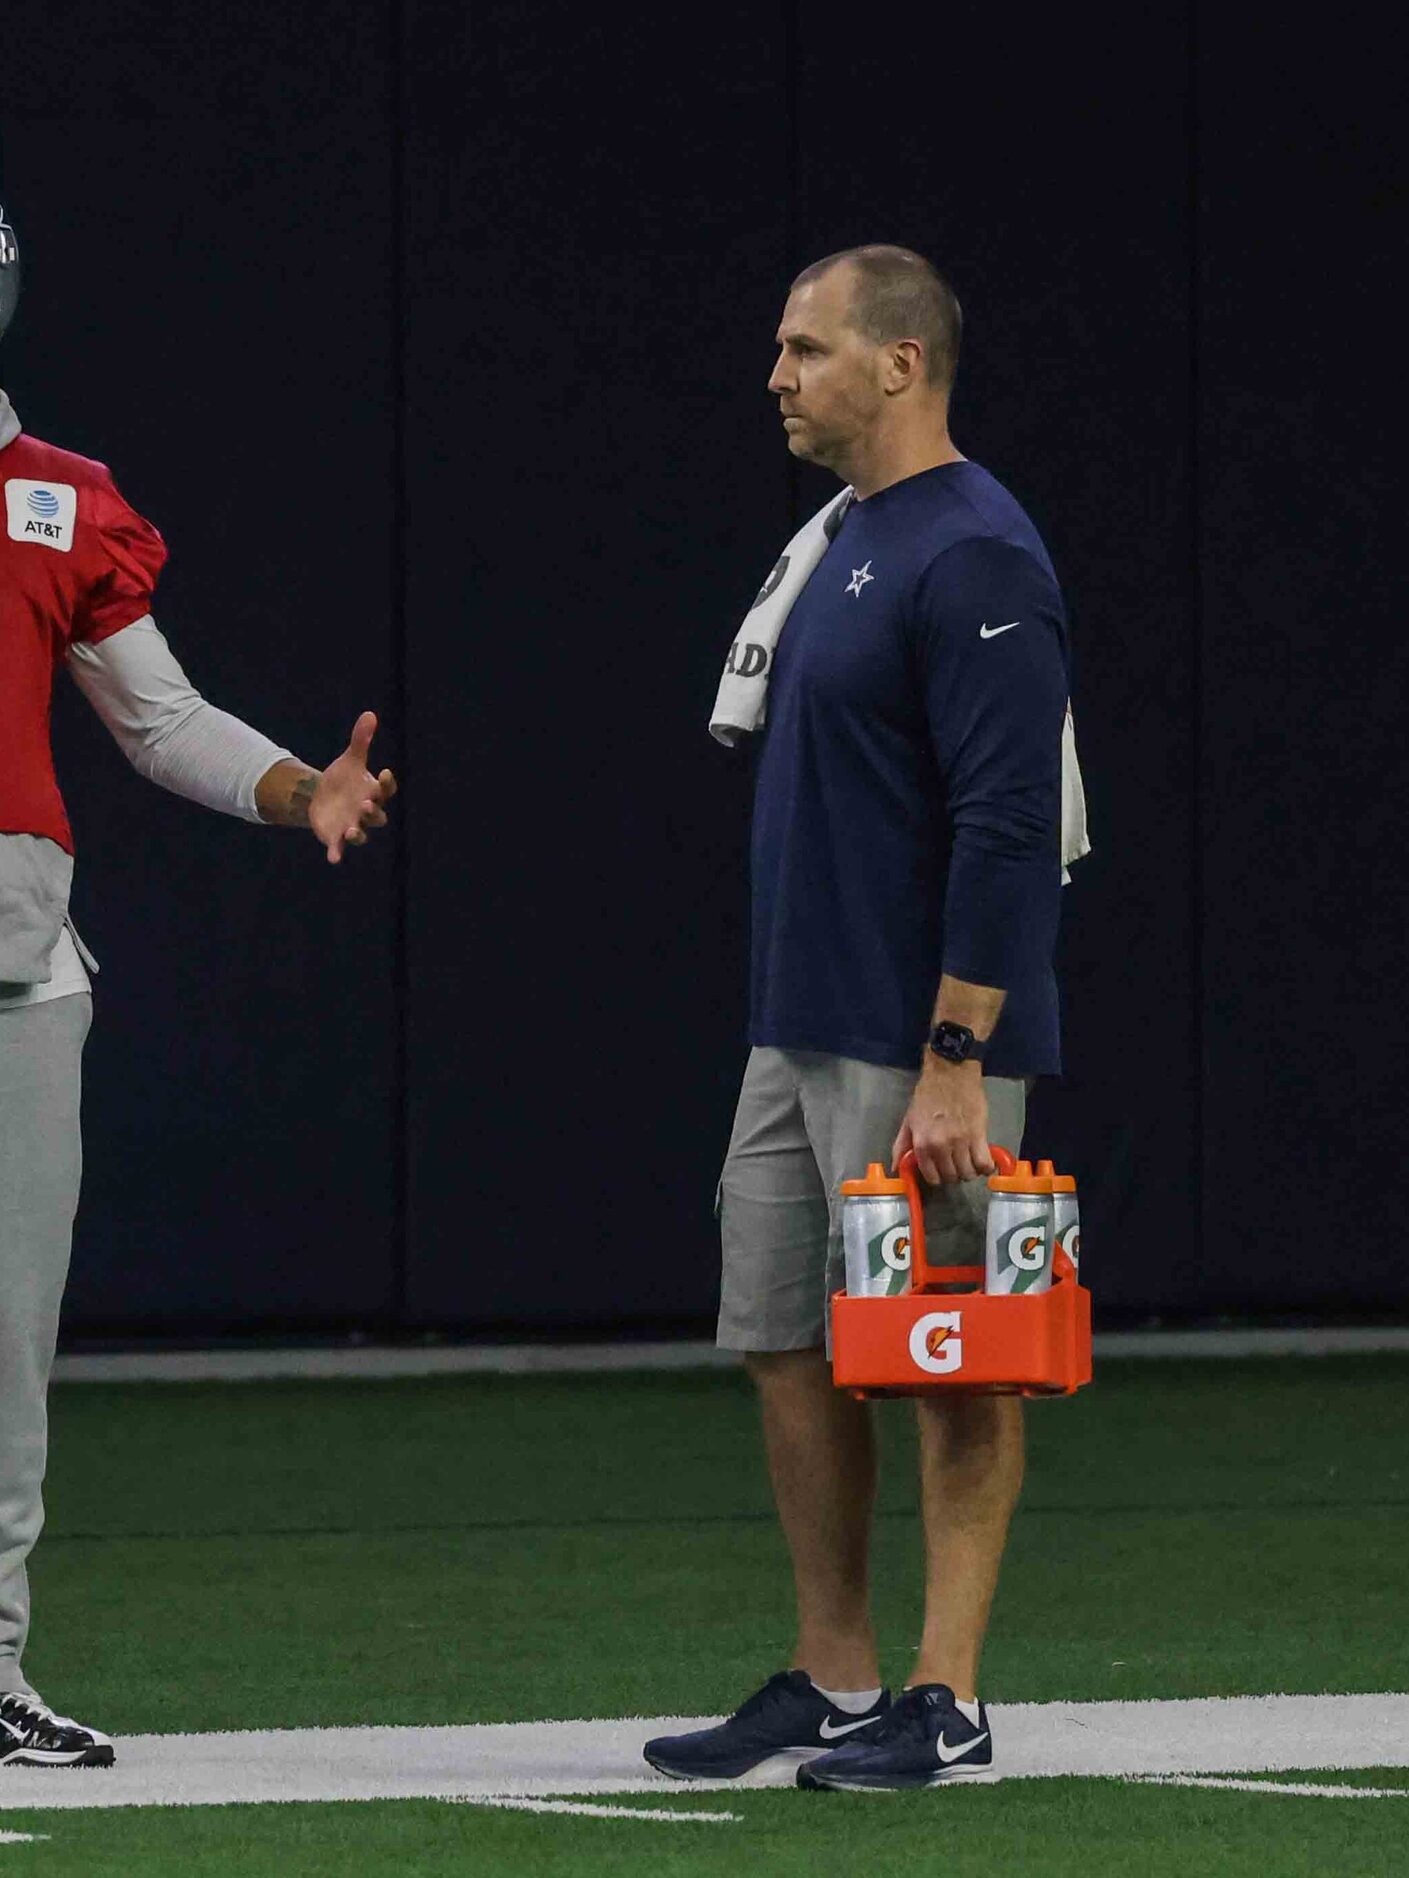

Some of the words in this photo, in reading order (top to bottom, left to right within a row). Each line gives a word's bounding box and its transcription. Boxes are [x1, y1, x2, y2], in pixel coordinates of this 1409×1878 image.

[24, 520, 62, 539] AT&T
[1007, 1226, 1046, 1271] G
[909, 1311, 962, 1374] G
